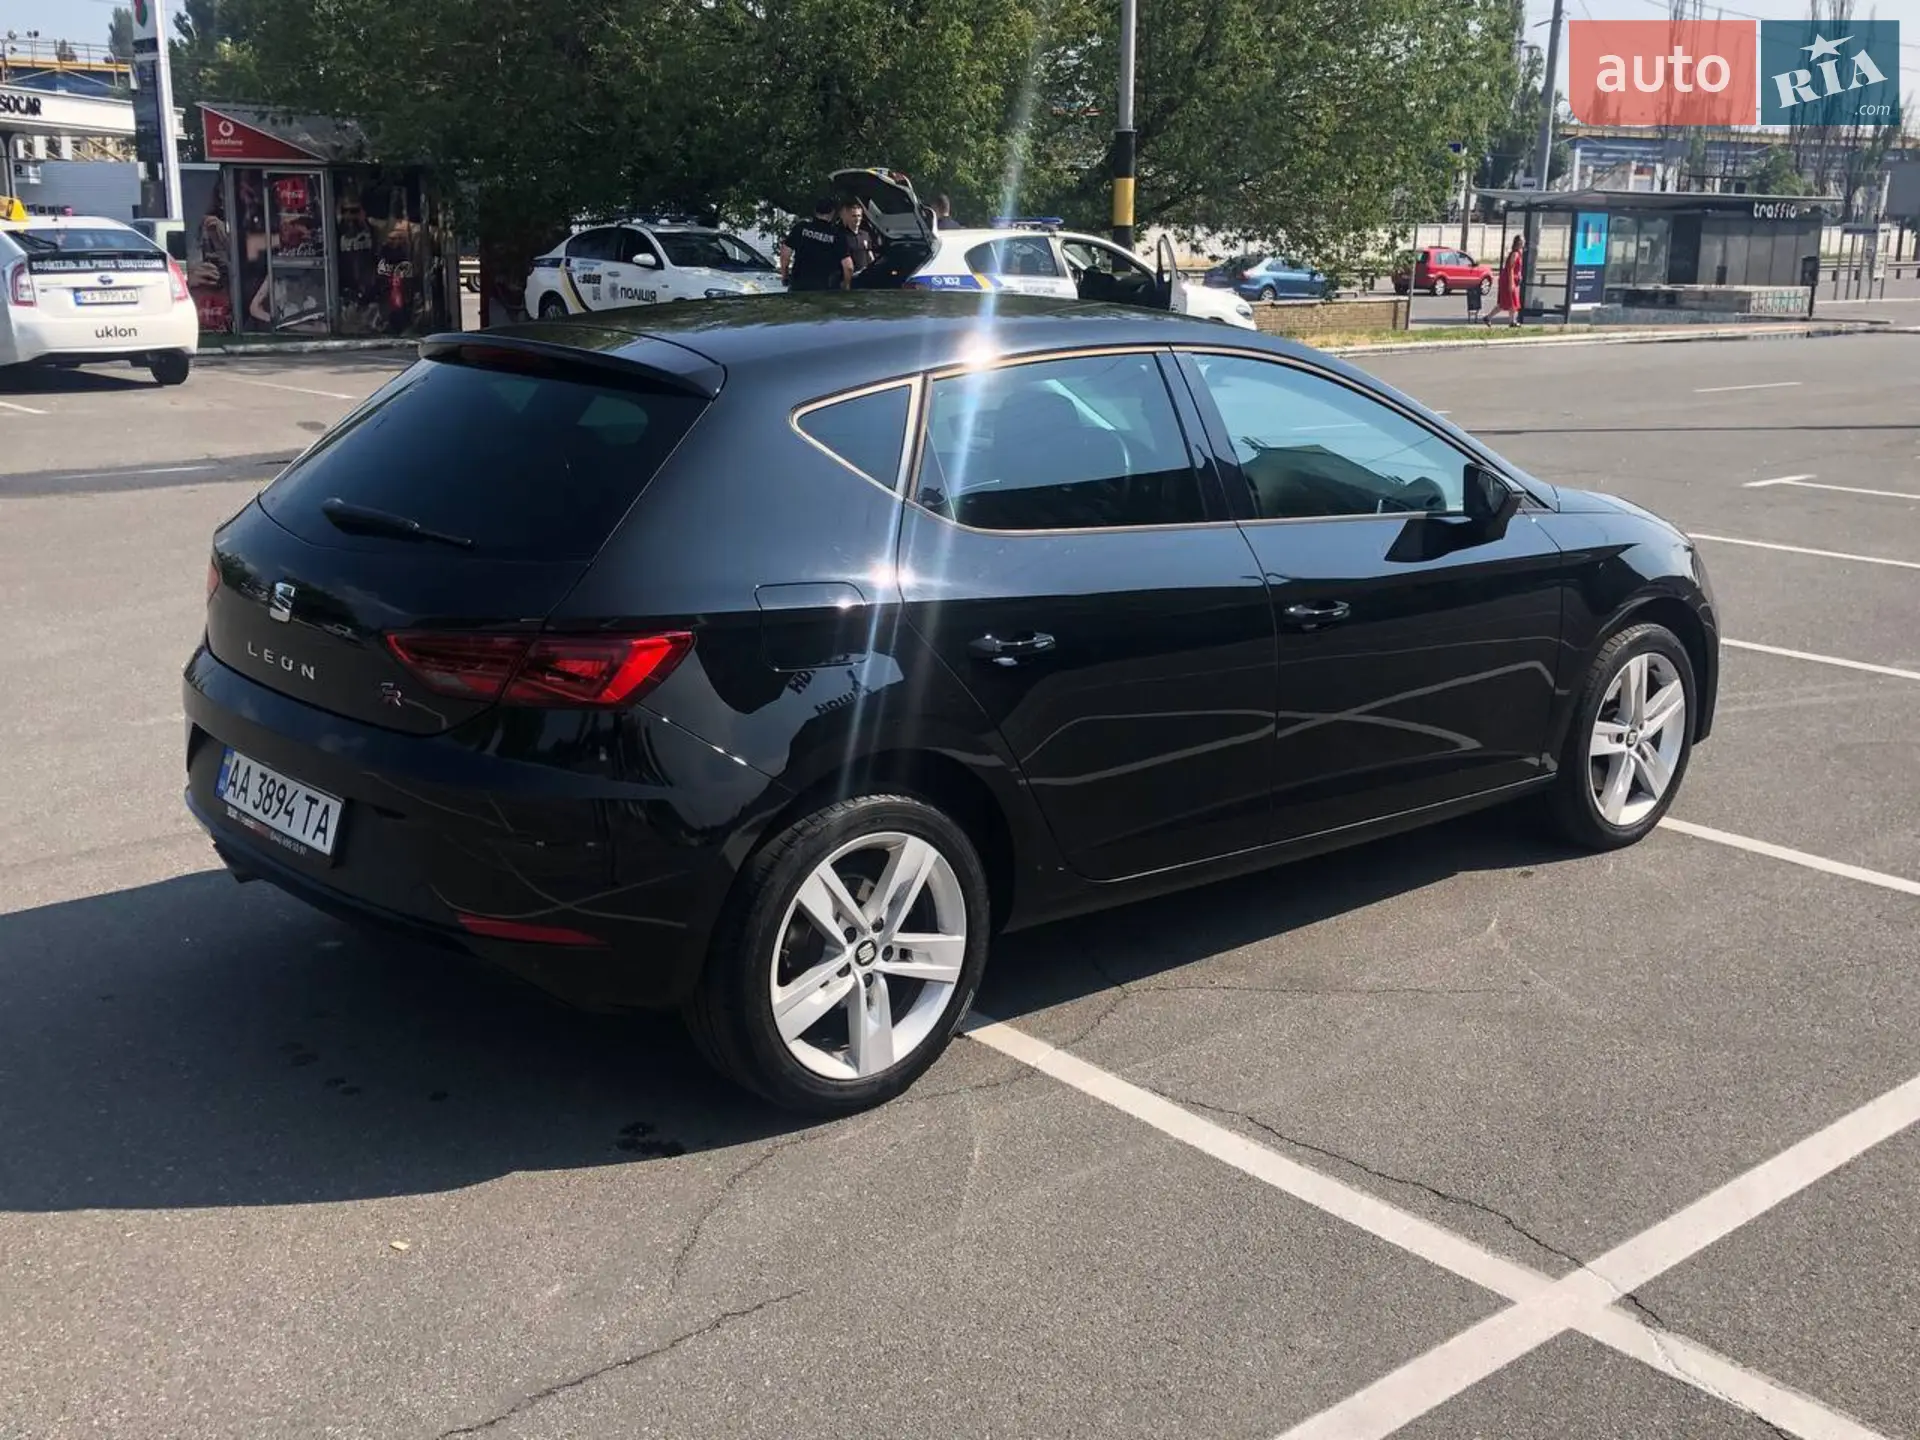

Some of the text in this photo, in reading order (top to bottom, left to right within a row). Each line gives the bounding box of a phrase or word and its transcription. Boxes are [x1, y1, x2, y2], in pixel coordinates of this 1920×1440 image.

[0, 94, 42, 116] SOCAR
[943, 276, 961, 286] 102
[95, 325, 138, 339] uklon
[247, 641, 316, 681] LEON
[227, 759, 252, 805] AA
[251, 771, 300, 829] 3894
[301, 794, 331, 847] TA
